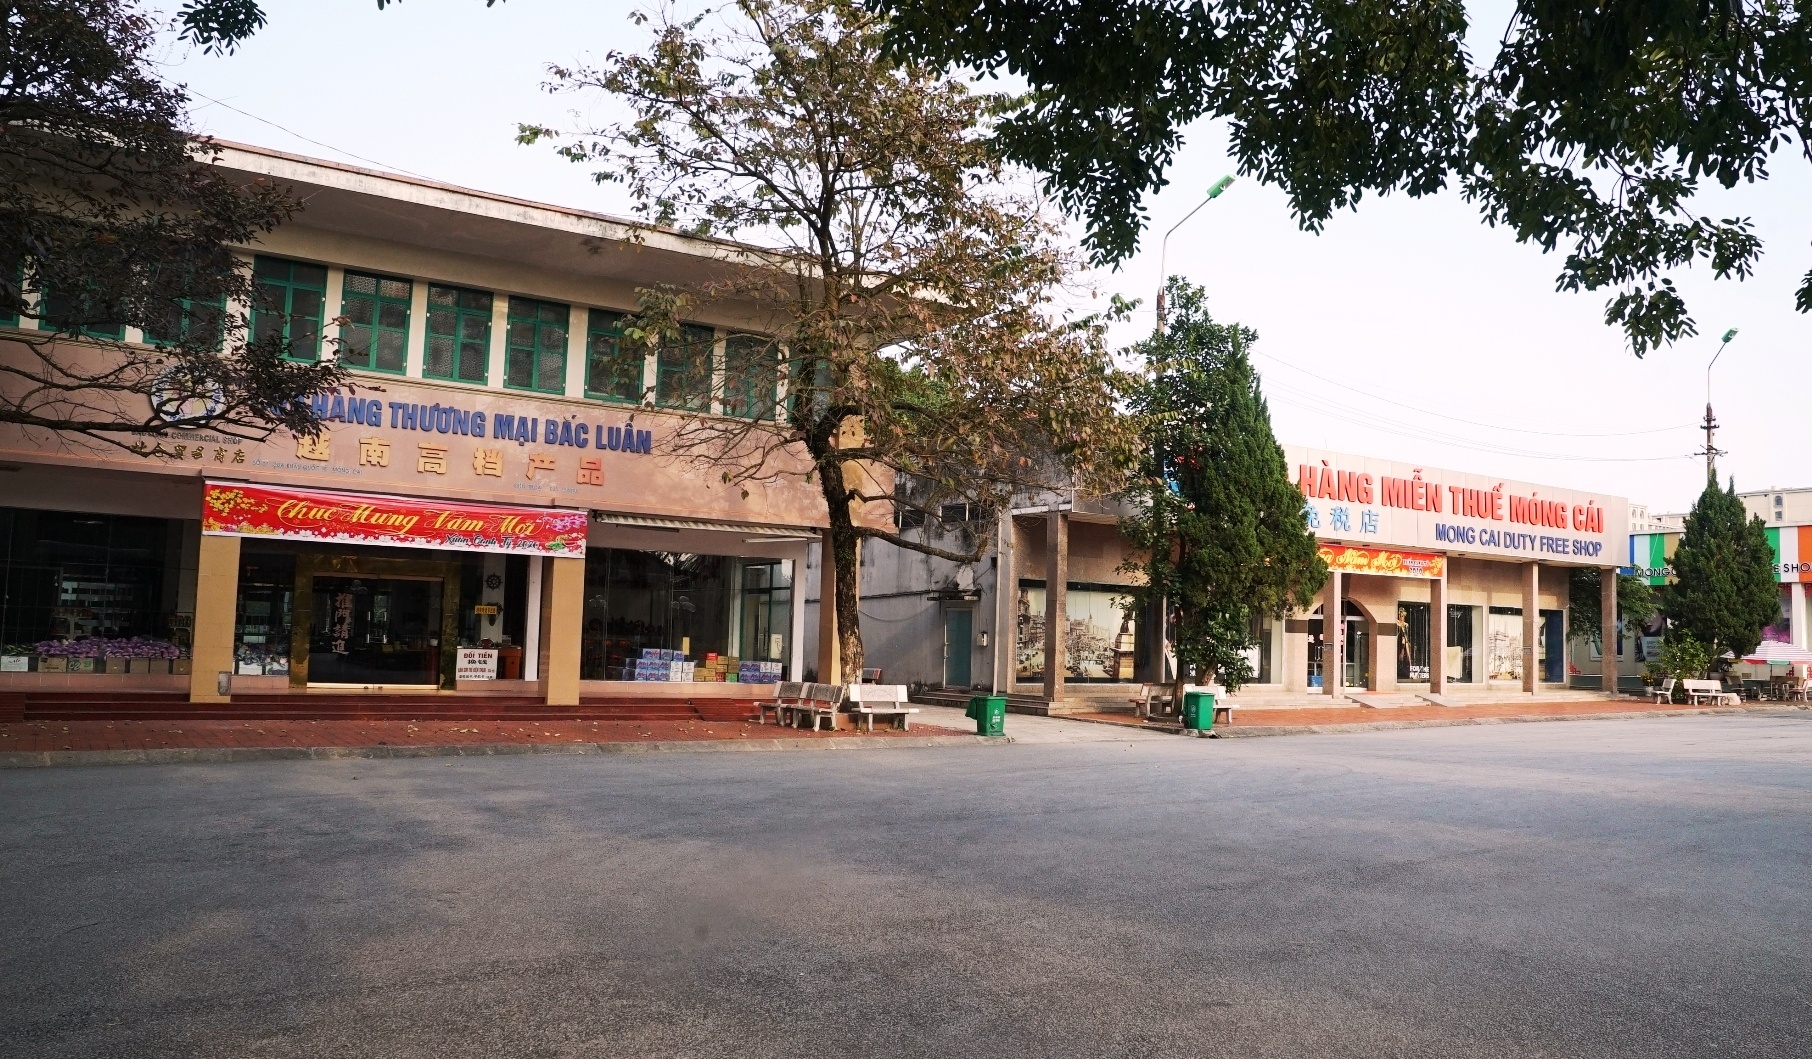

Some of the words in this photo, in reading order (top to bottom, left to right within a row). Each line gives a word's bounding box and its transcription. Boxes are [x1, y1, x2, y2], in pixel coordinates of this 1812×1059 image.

[171, 431, 220, 443] COMMERCIAL
[222, 436, 243, 445] SHOP
[311, 388, 382, 427] HÀNG
[388, 401, 487, 438] THƯƠNG
[493, 413, 538, 446] MẠI
[544, 414, 589, 449] BẮC
[595, 422, 652, 455] LUÂN
[1299, 459, 1373, 504] HÀNG
[1381, 468, 1442, 513] MIỄN
[1449, 483, 1504, 521] THUẾ
[1509, 492, 1568, 529] MÓNG
[1572, 499, 1604, 533] CÁI
[1435, 522, 1476, 545] MONG
[1479, 528, 1501, 547] CAI
[1504, 531, 1537, 550] DUTY
[1539, 535, 1570, 555] FREE
[1572, 539, 1603, 557] SHOP
[1636, 567, 1677, 577] MONGC
[1783, 562, 1812, 573] SHO
